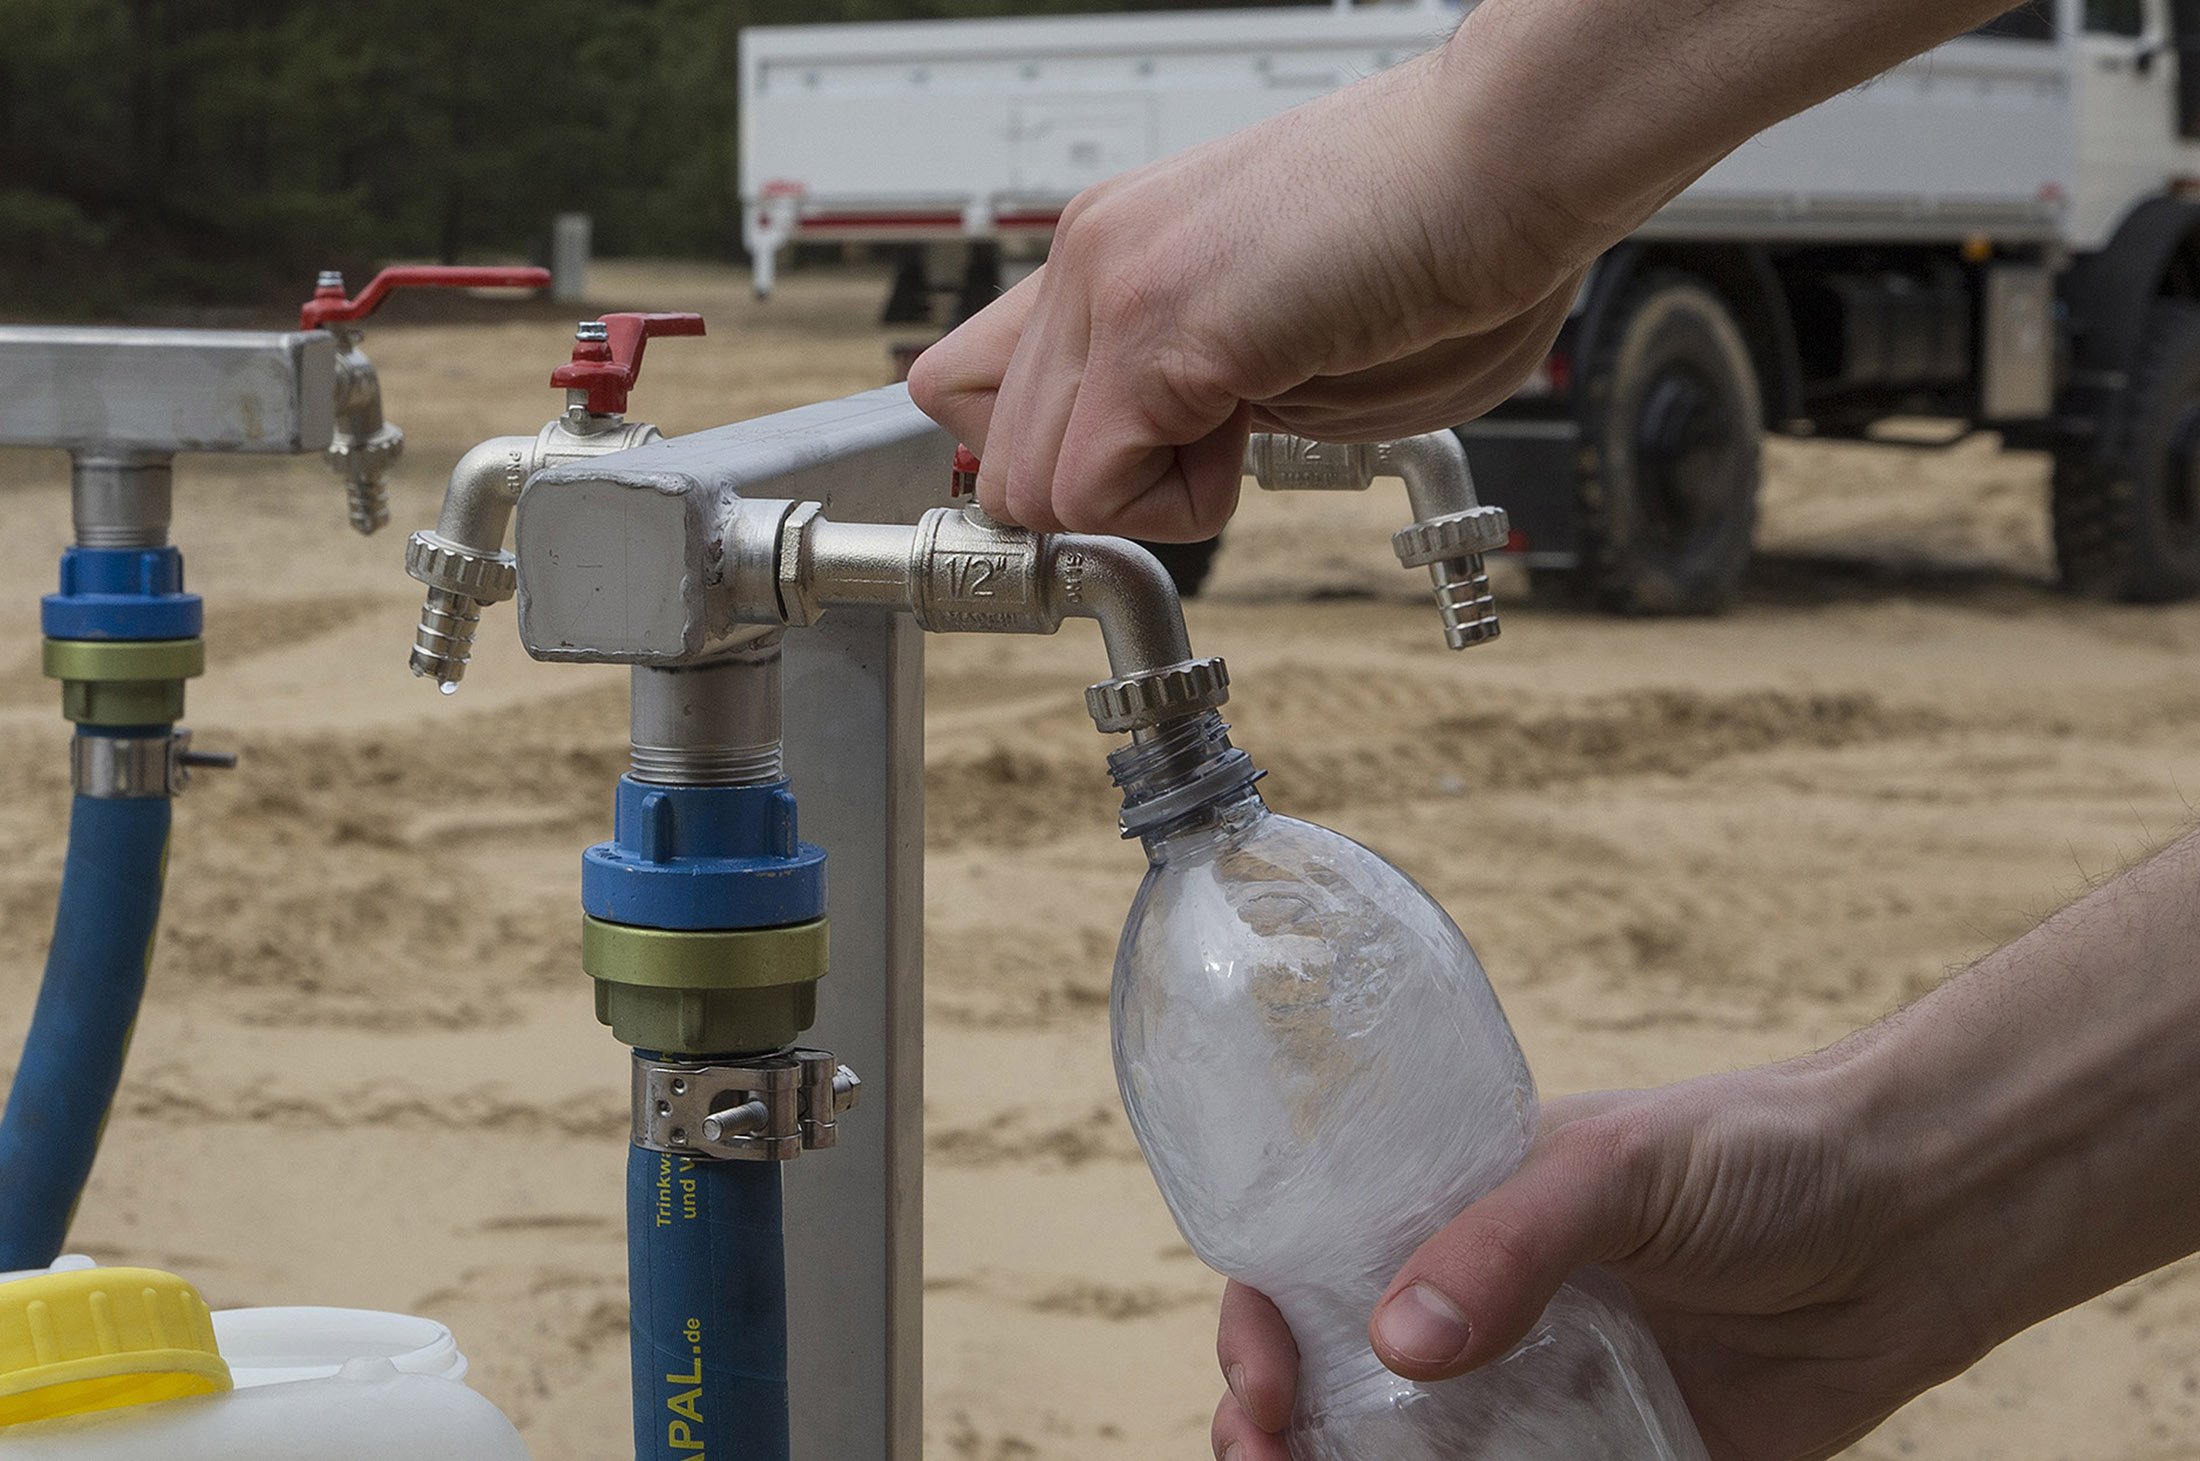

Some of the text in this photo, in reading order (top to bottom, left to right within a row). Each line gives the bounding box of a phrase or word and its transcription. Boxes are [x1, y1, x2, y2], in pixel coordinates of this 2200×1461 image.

[945, 555, 1007, 597] 1/2"
[680, 1178, 697, 1219] und
[666, 1317, 705, 1461] PAL.de
